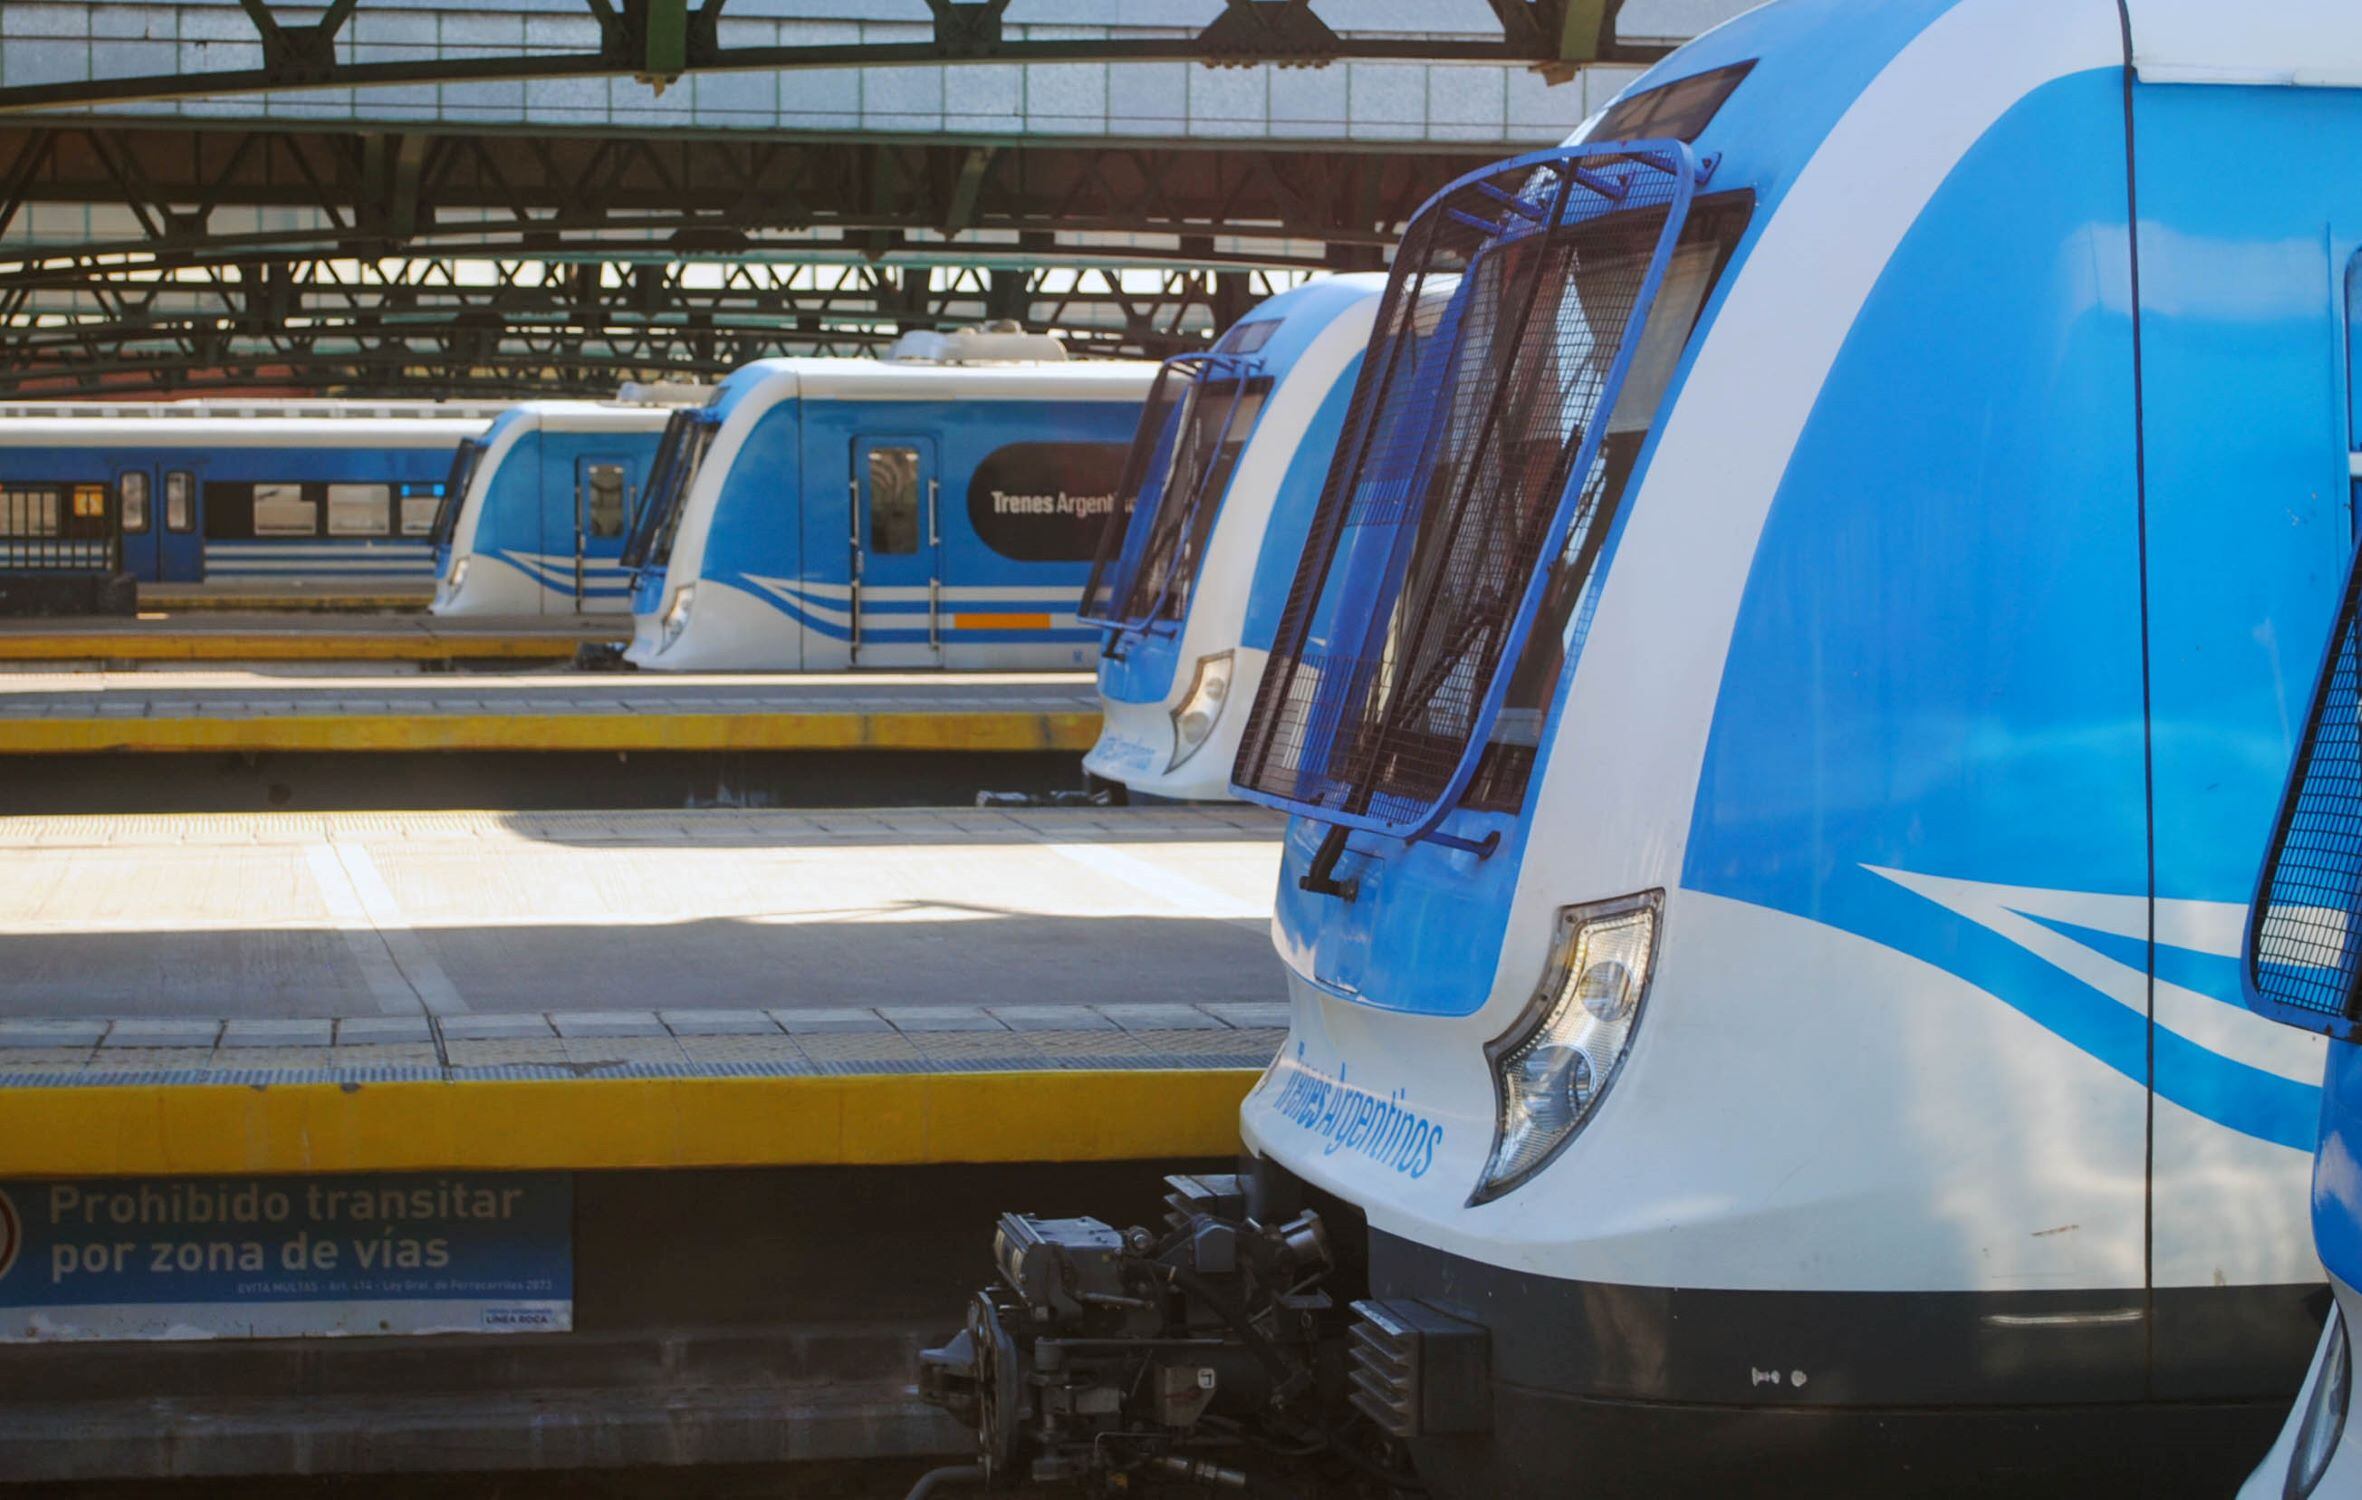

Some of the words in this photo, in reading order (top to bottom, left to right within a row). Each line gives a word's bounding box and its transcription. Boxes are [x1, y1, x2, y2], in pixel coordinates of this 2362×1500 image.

[990, 490, 1055, 514] Trenes
[1315, 1061, 1443, 1179] Argentinos
[48, 1182, 290, 1225] Prohibido
[307, 1180, 523, 1222] transitar
[51, 1239, 137, 1283] por
[150, 1238, 264, 1273] zona
[281, 1231, 340, 1271] de
[354, 1226, 450, 1269] vías
[237, 1281, 271, 1294] EVITA
